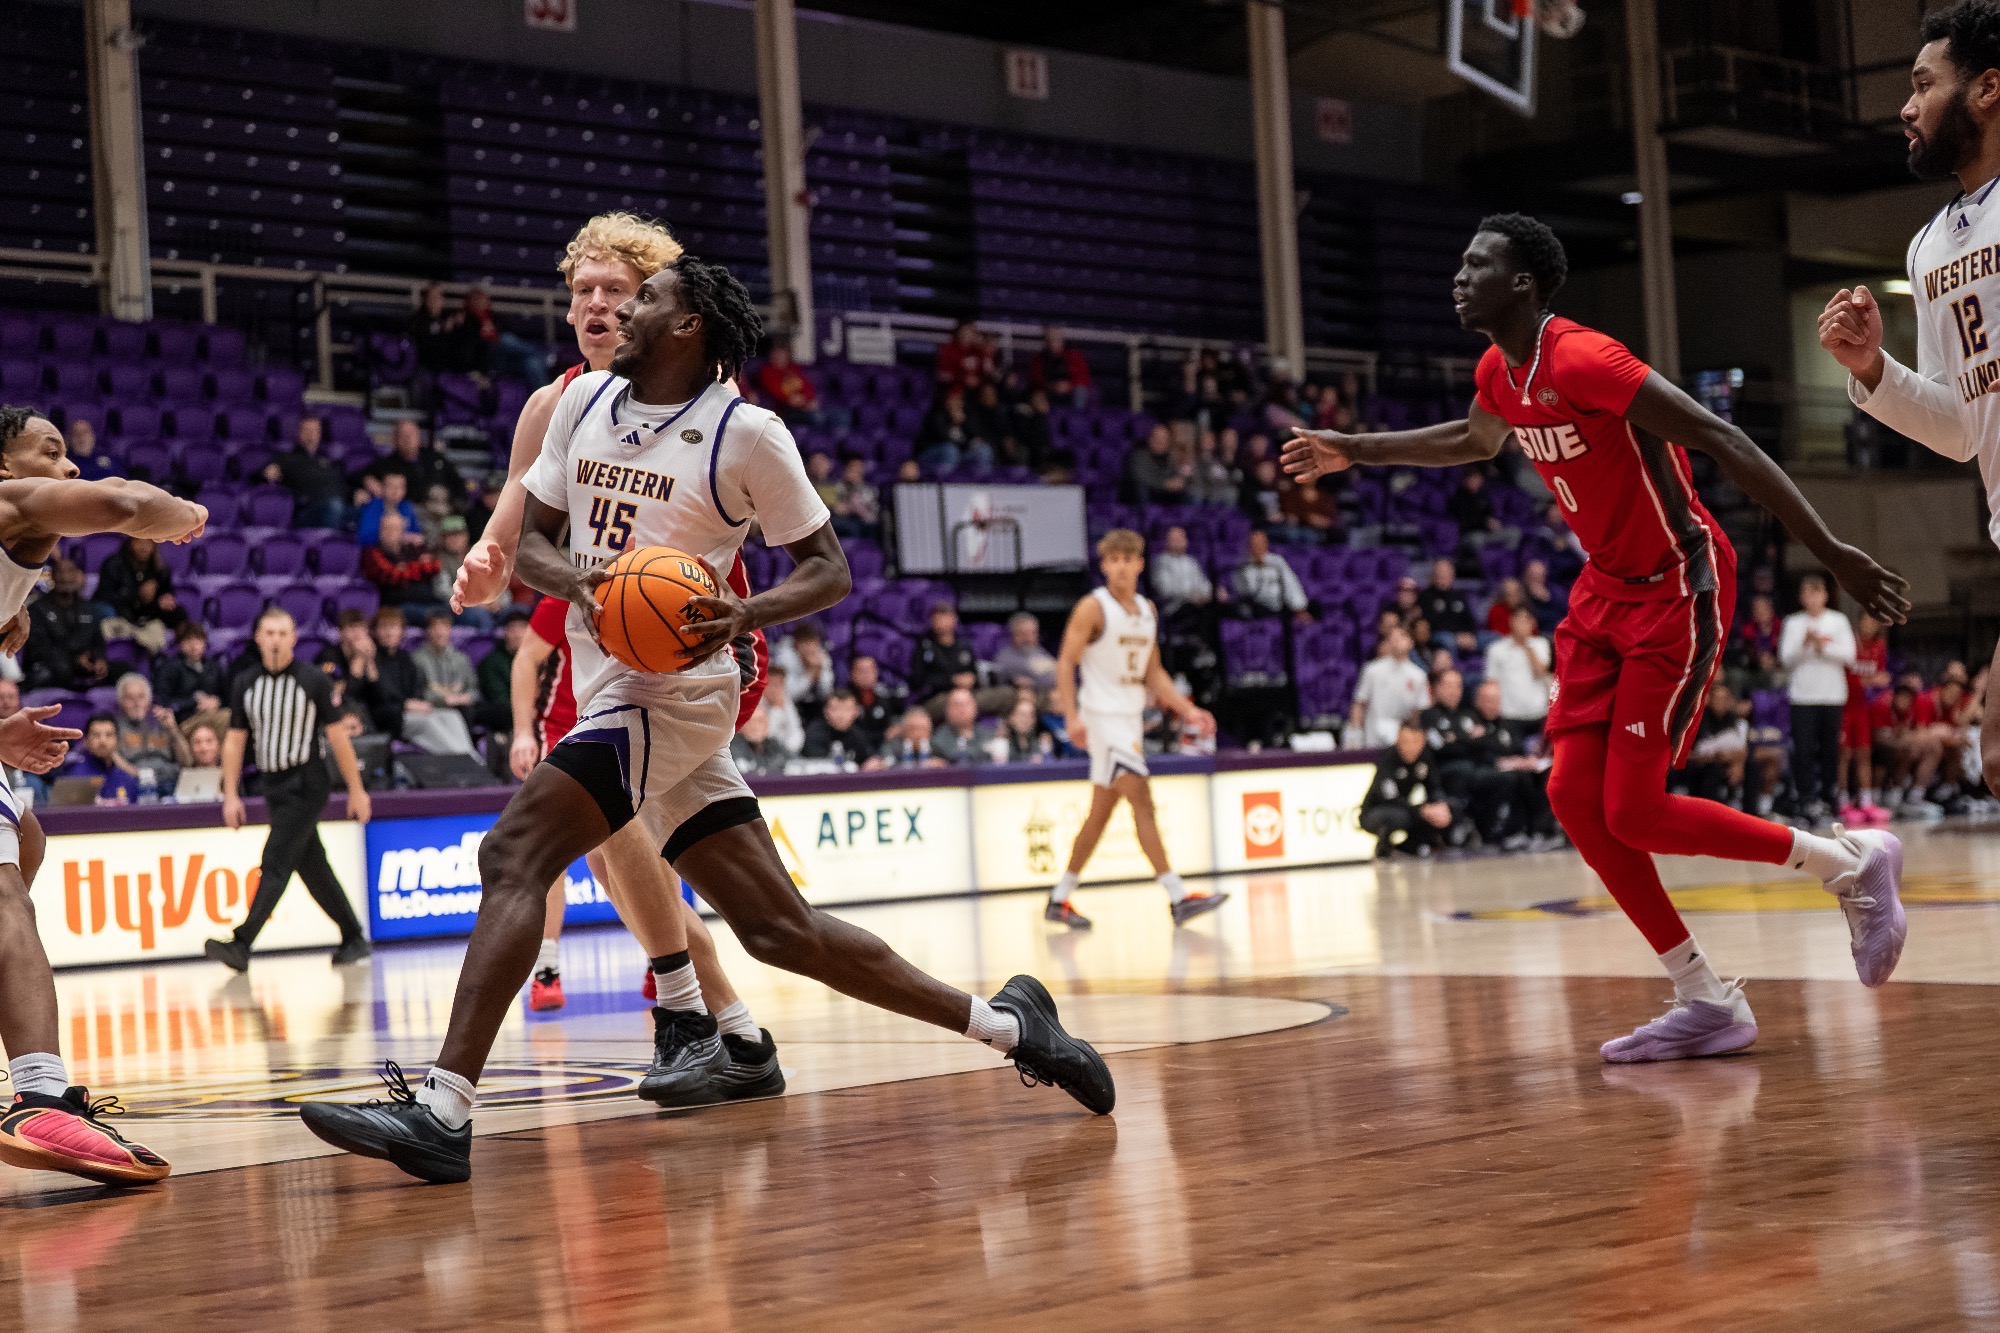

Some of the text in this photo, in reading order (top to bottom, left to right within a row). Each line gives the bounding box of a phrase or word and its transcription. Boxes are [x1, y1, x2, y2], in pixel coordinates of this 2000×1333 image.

[1949, 292, 1989, 361] 12
[1514, 421, 1589, 463] SIUE
[576, 457, 676, 503] WESTERN
[1553, 475, 1579, 513] 0
[588, 495, 640, 553] 45
[817, 805, 924, 848] APEX
